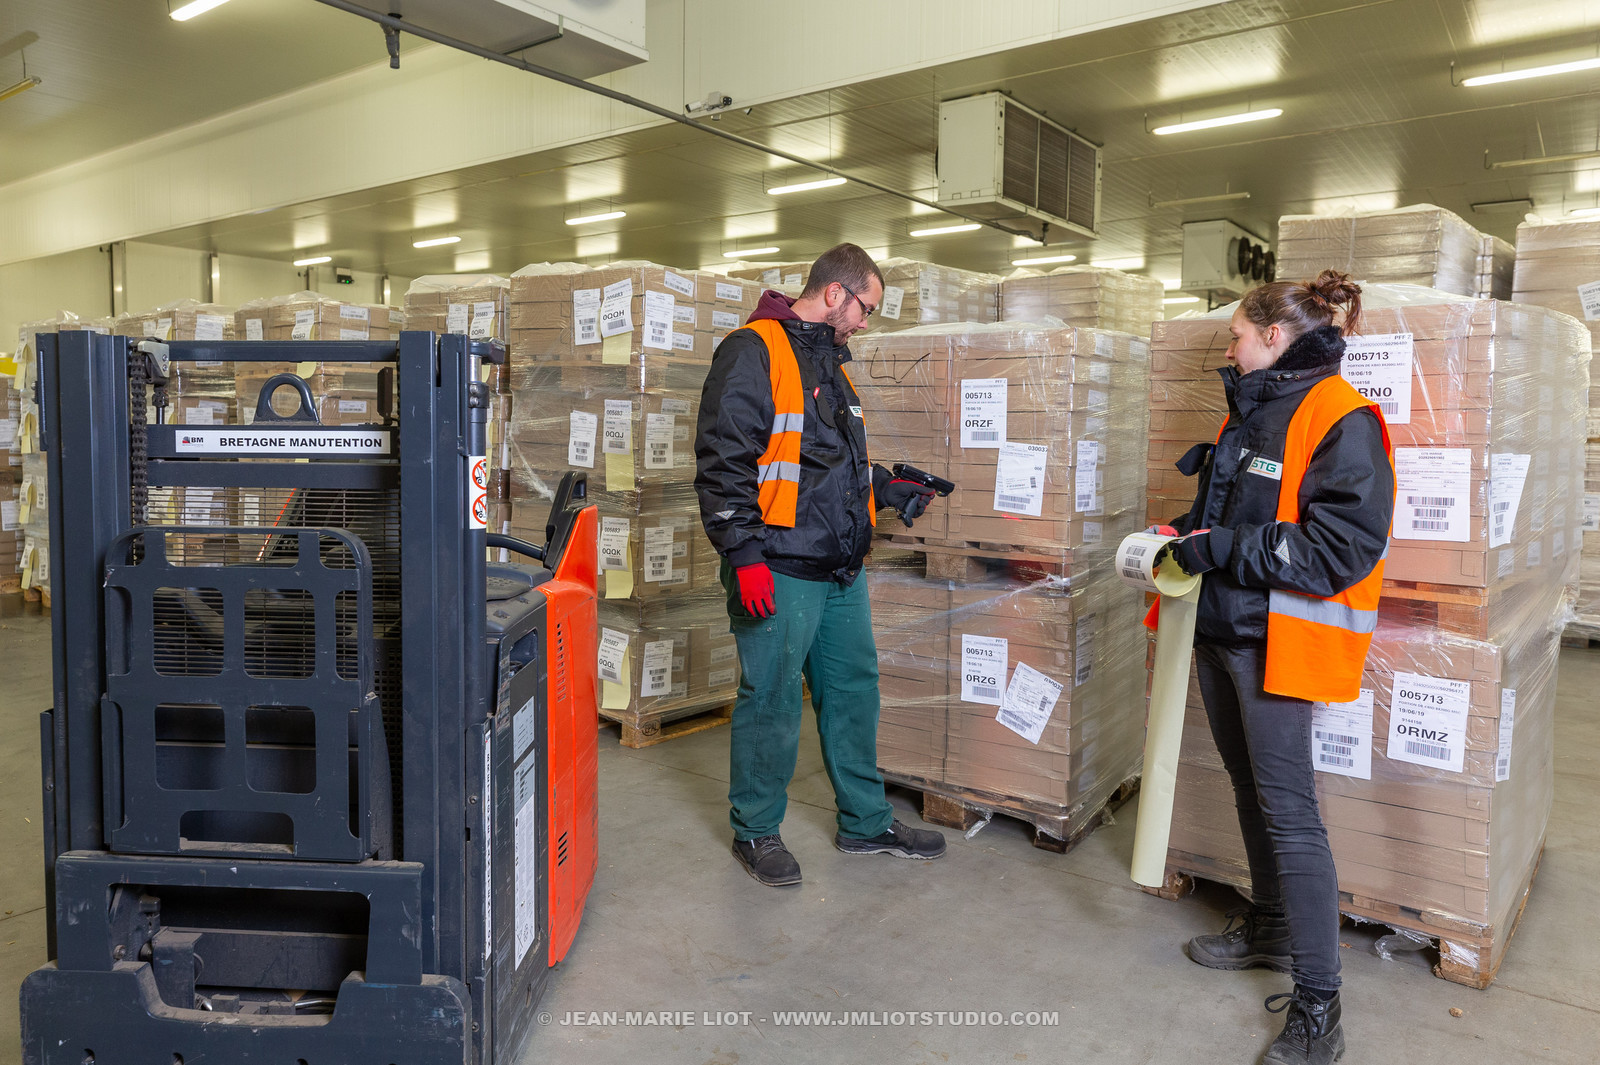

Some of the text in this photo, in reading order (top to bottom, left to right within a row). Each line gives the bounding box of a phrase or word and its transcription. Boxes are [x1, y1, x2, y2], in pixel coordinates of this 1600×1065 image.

[603, 310, 624, 320] 0QQH
[1348, 352, 1389, 360] 005713
[1358, 387, 1392, 397] RN0
[220, 438, 285, 447] BRETAGNE
[290, 438, 382, 447] MANUTENTION
[1251, 460, 1277, 473] STG
[966, 648, 992, 656] 005713
[599, 659, 615, 669] 0QQL
[966, 674, 996, 685] 0RZG
[1400, 690, 1443, 704] 005713
[1398, 708, 1424, 716] 19/06/19
[1397, 724, 1448, 743] 0RMZ
